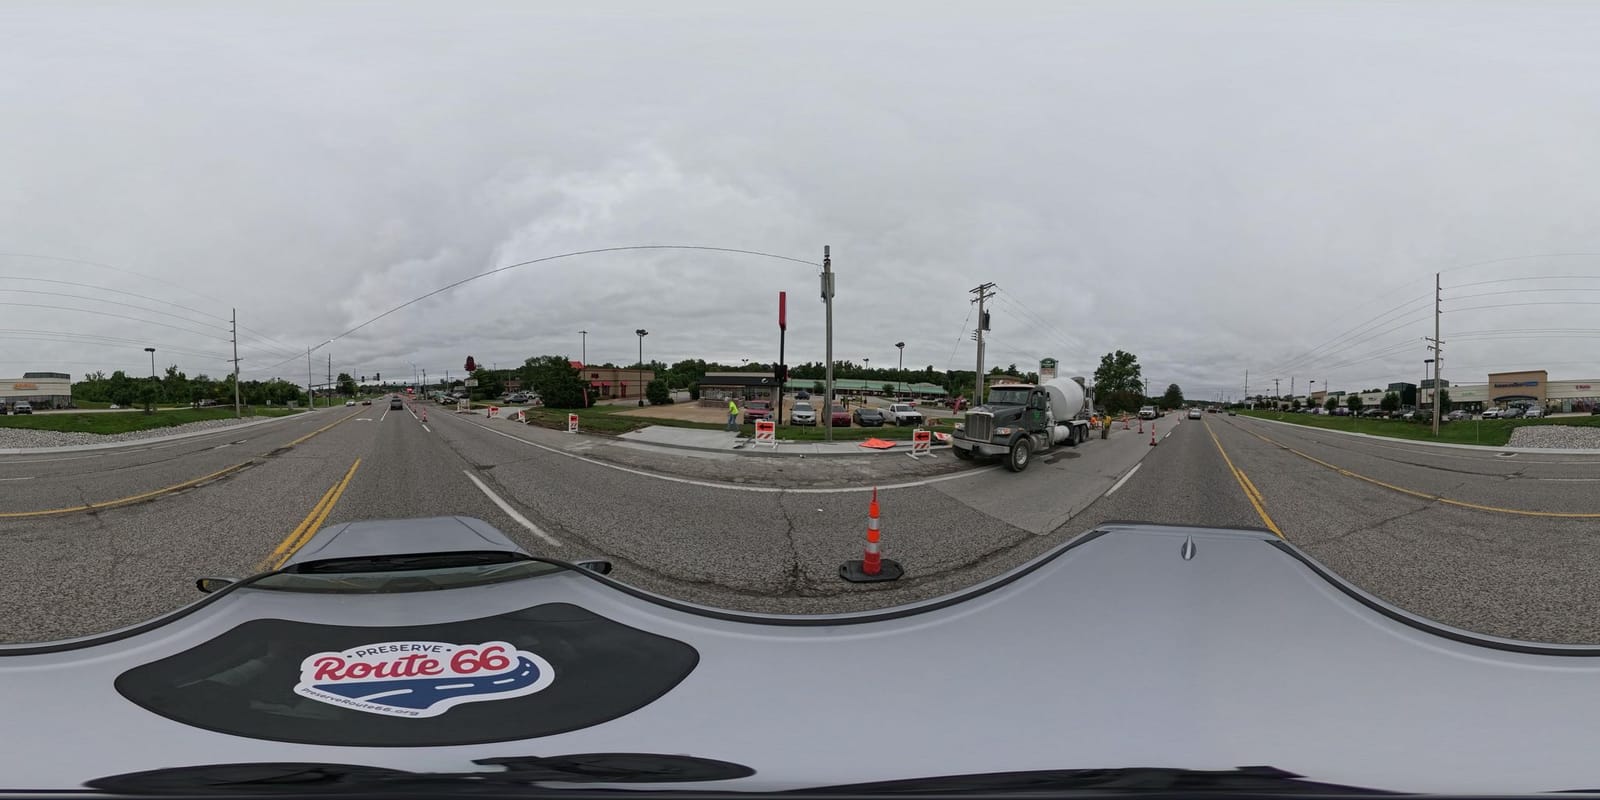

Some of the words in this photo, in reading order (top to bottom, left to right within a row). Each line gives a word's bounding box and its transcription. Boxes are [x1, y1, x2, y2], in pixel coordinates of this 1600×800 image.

[355, 644, 443, 657] PRESERVE
[314, 654, 444, 681] Route
[450, 645, 510, 674] 66
